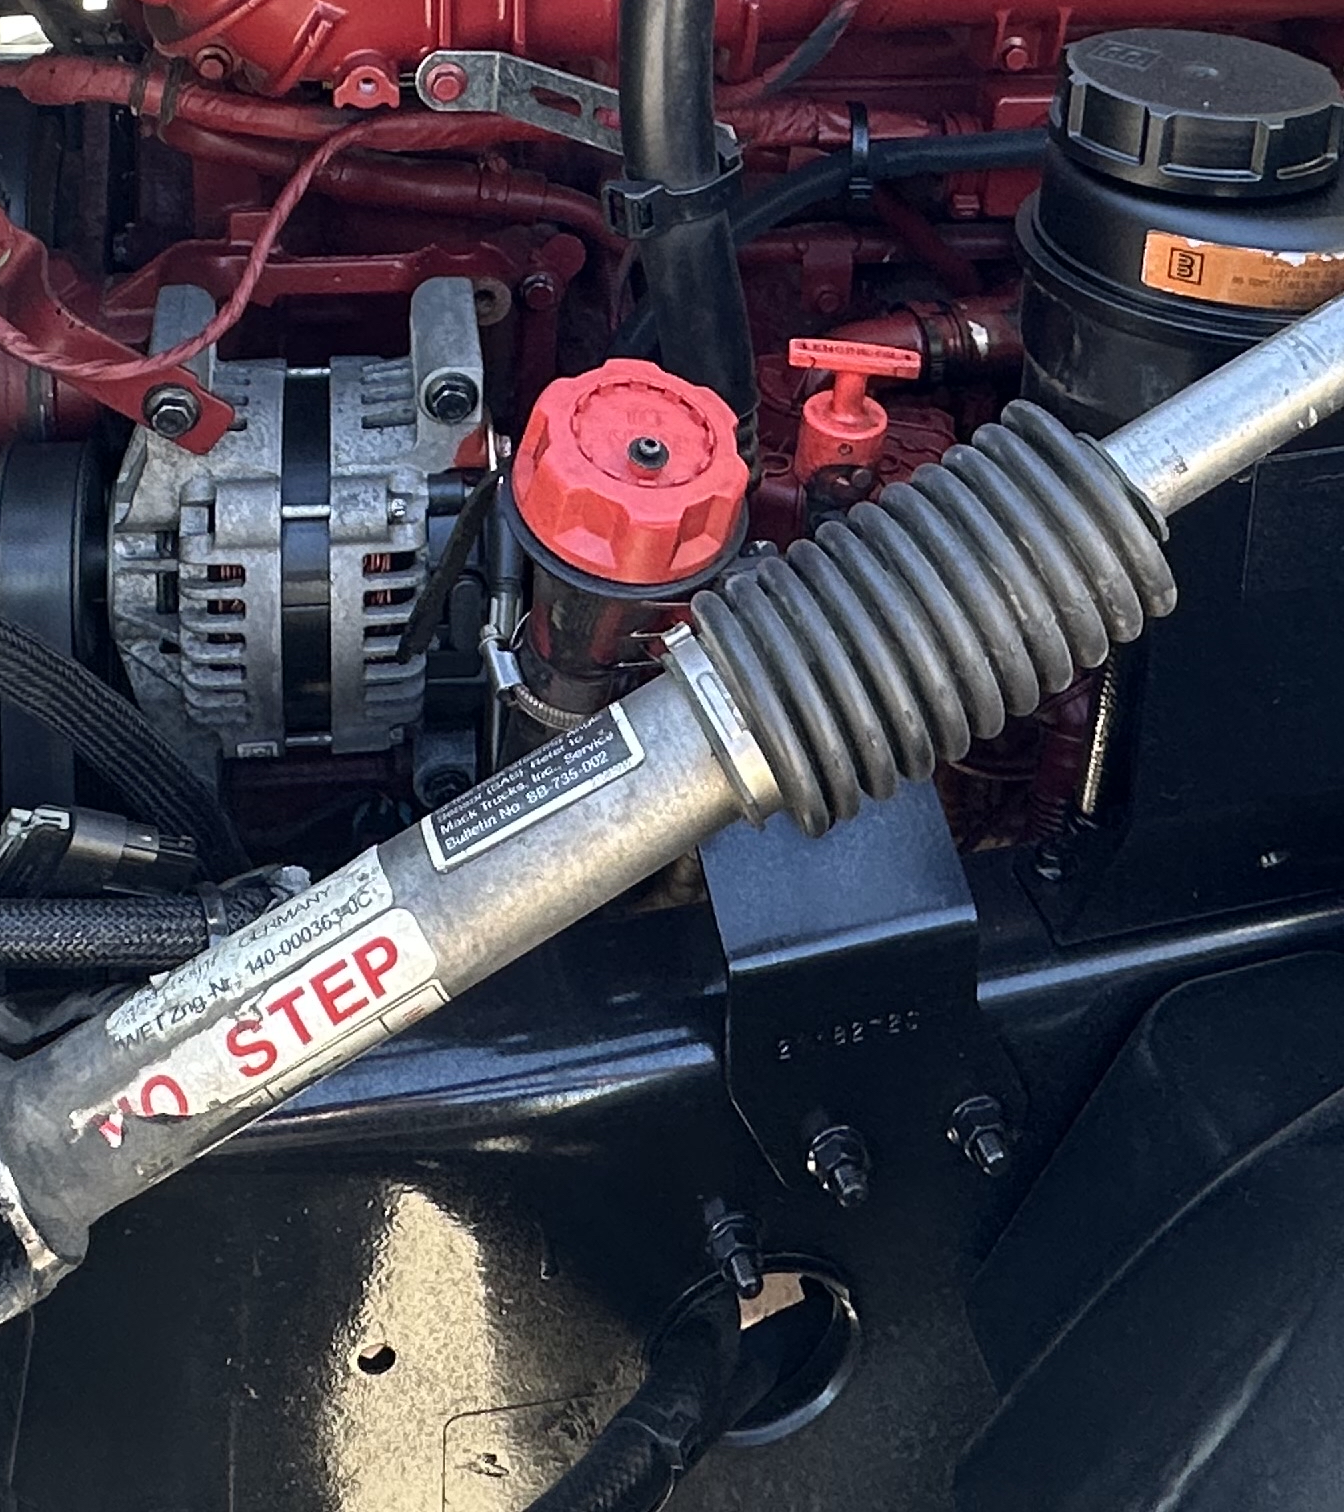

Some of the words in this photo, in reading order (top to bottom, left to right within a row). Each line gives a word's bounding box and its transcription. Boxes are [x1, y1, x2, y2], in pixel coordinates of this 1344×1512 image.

[439, 809, 479, 835] Mack
[444, 814, 499, 851] Bulletin
[225, 936, 398, 1078] STEP
